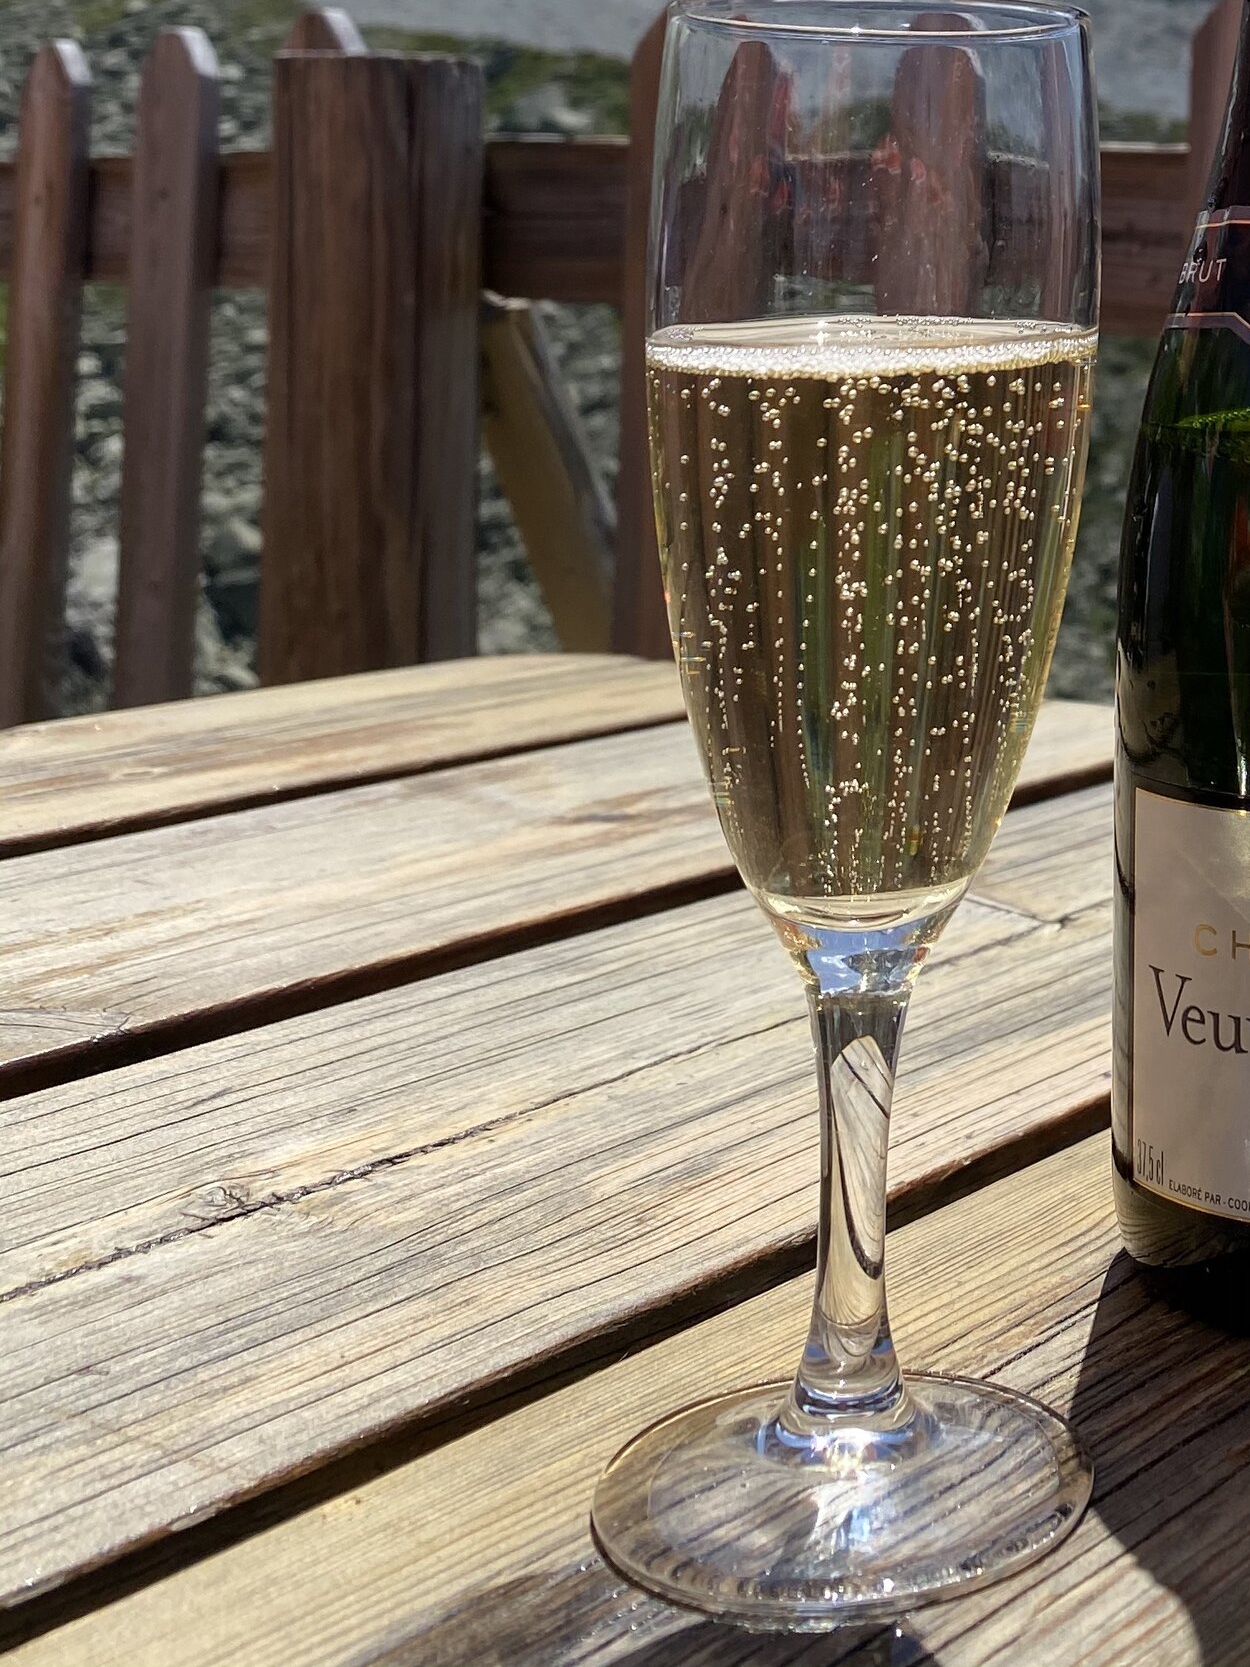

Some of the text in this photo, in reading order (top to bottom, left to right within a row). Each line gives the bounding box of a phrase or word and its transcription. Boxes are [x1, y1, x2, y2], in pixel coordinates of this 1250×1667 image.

[1178, 257, 1227, 285] BRUT
[1136, 1138, 1165, 1186] 37,5 cl
[1168, 1179, 1203, 1200] ELABORÉ
[1204, 1192, 1222, 1206] PAR
